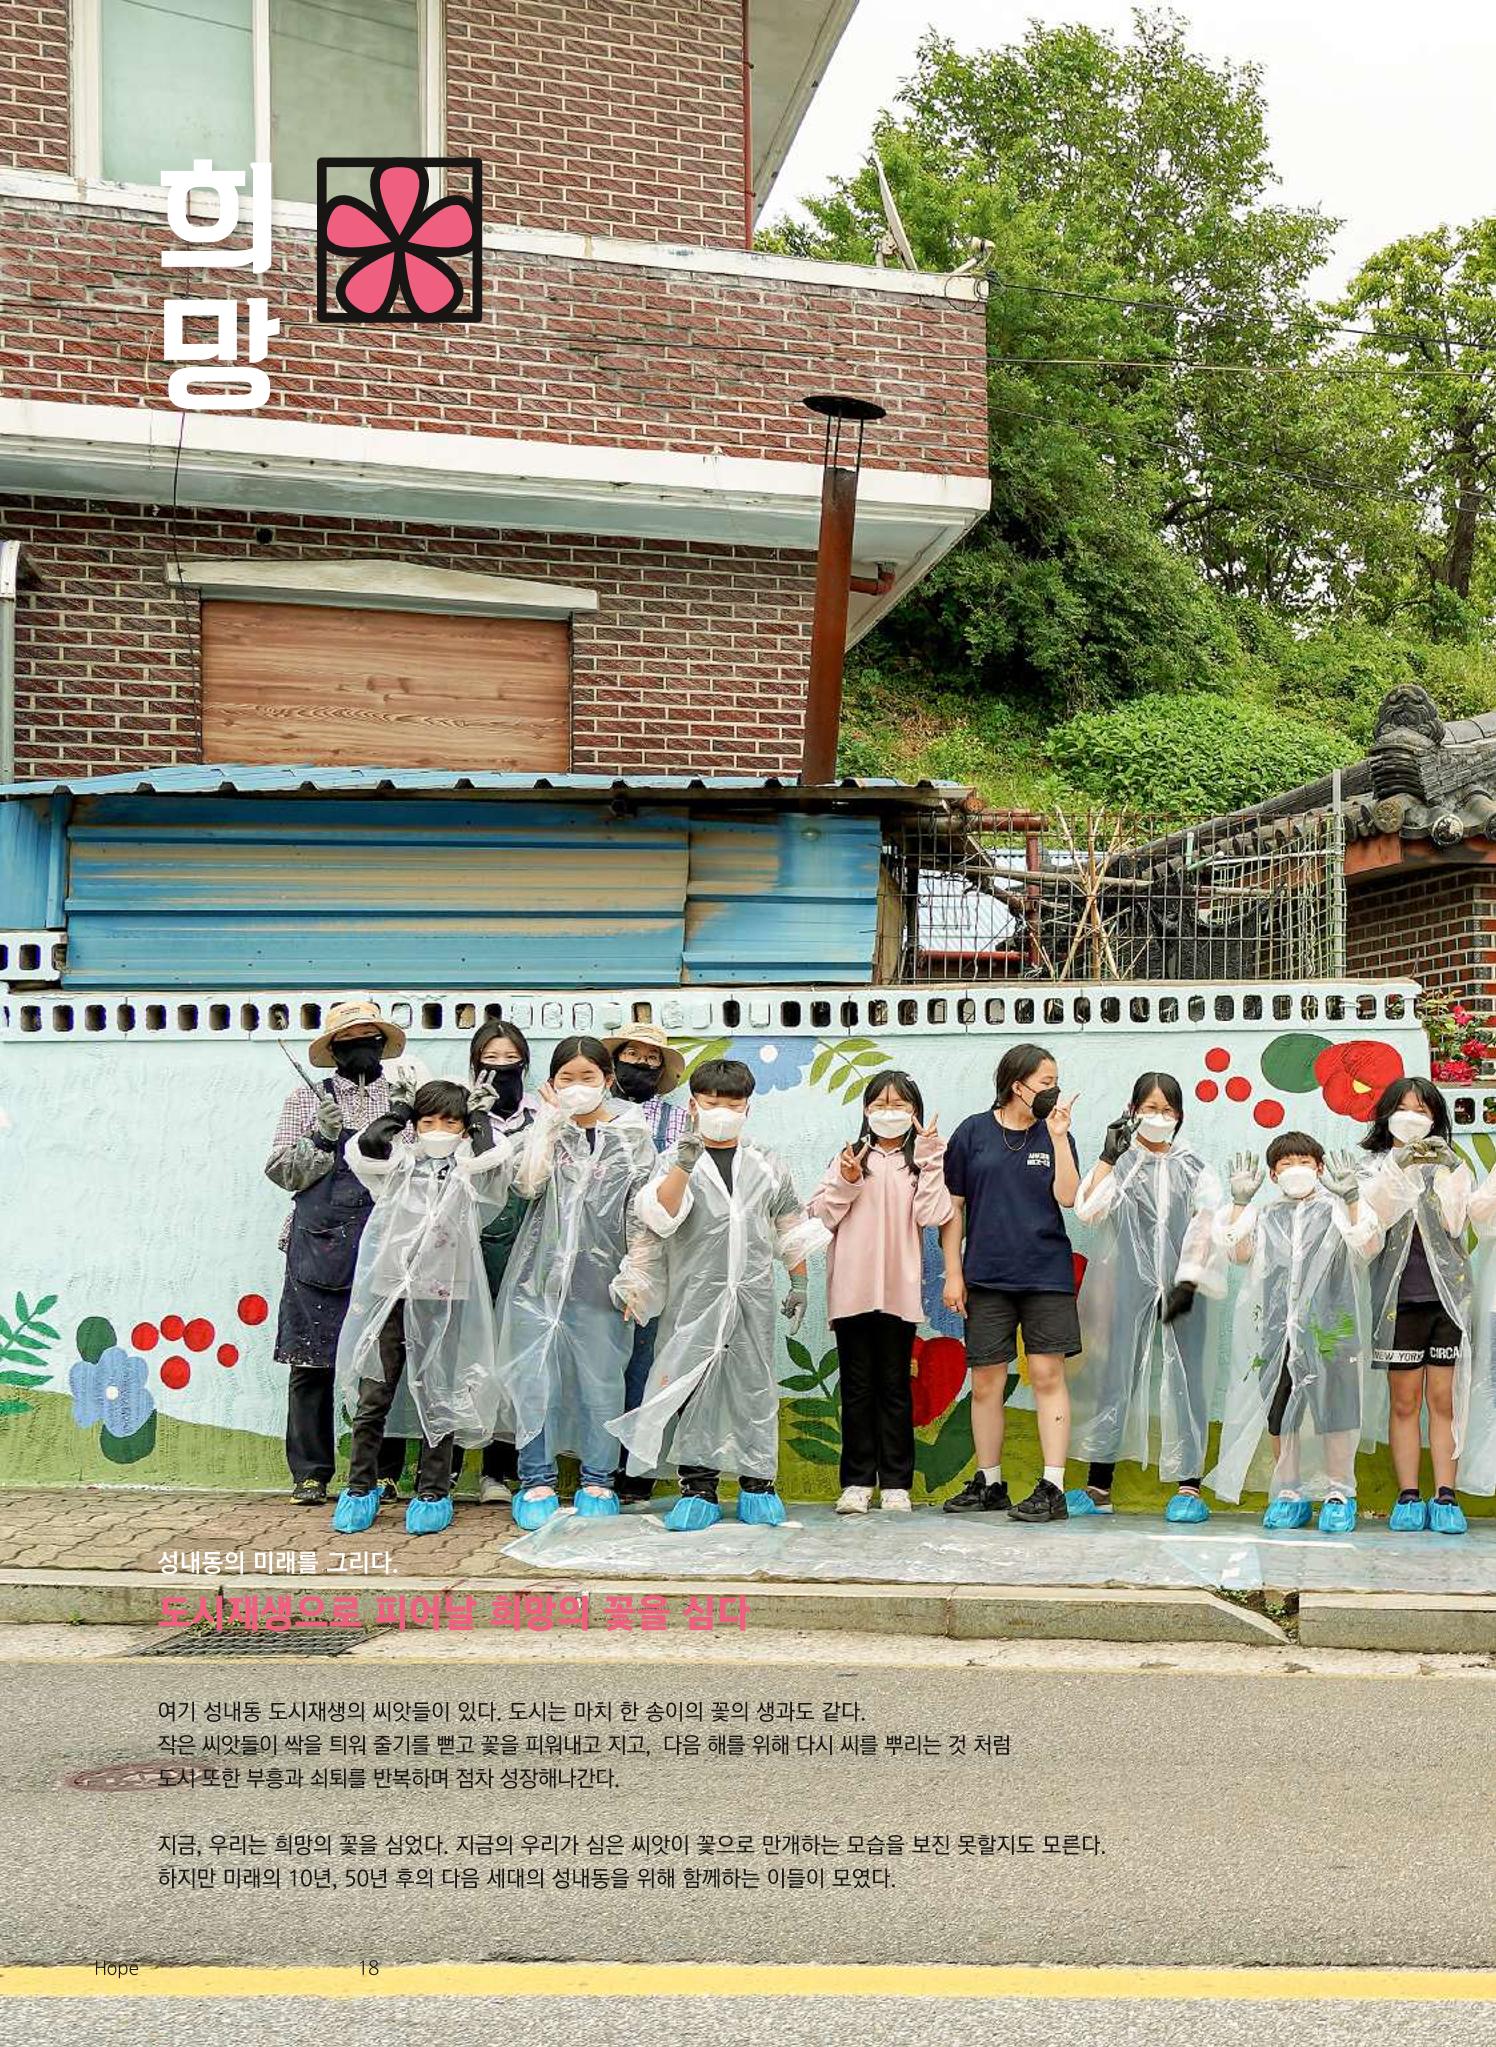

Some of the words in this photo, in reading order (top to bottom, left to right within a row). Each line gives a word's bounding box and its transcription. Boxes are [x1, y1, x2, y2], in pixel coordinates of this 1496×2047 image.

[1373, 1351, 1394, 1361] NEW
[1398, 1351, 1423, 1362] YORK
[1429, 1346, 1460, 1360] CIRCA
